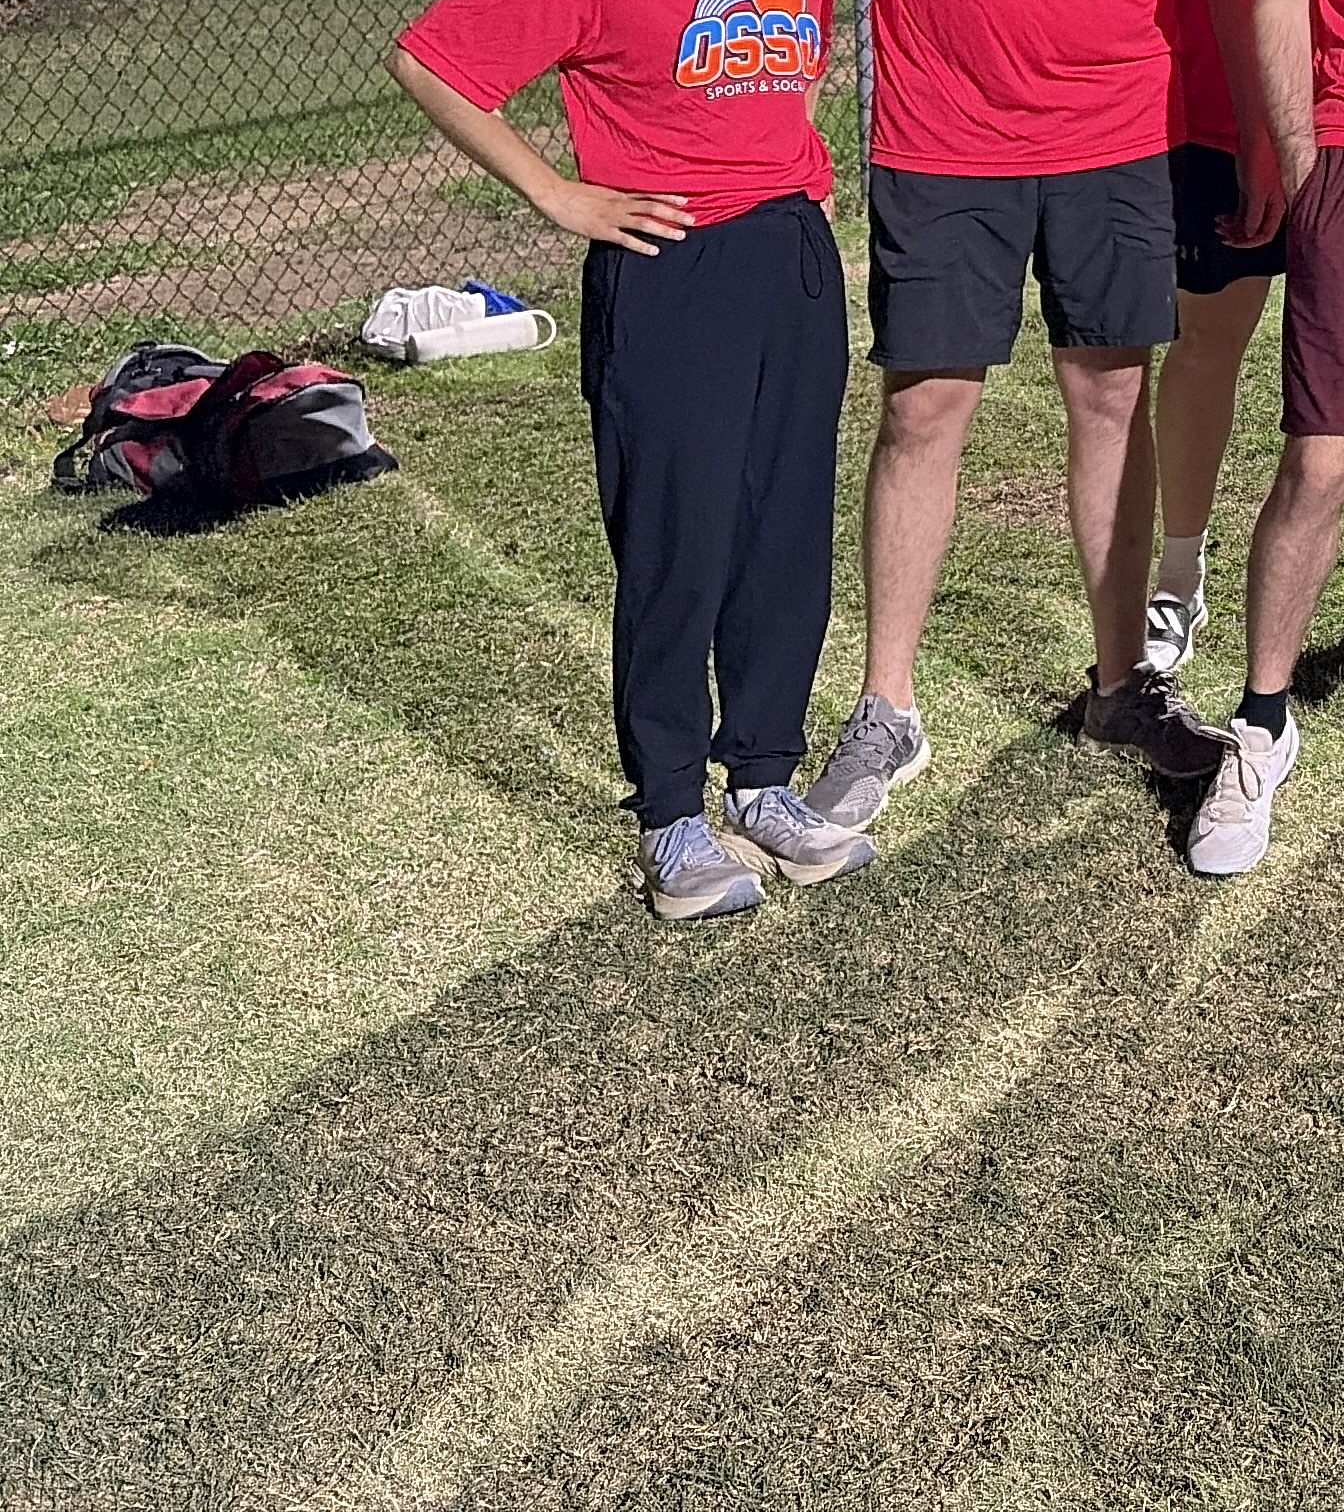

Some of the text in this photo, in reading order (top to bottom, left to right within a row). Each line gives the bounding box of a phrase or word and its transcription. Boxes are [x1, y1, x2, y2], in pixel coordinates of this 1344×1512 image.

[676, 10, 821, 88] OSSO
[706, 81, 756, 100] SPORTS
[758, 80, 769, 92] &
